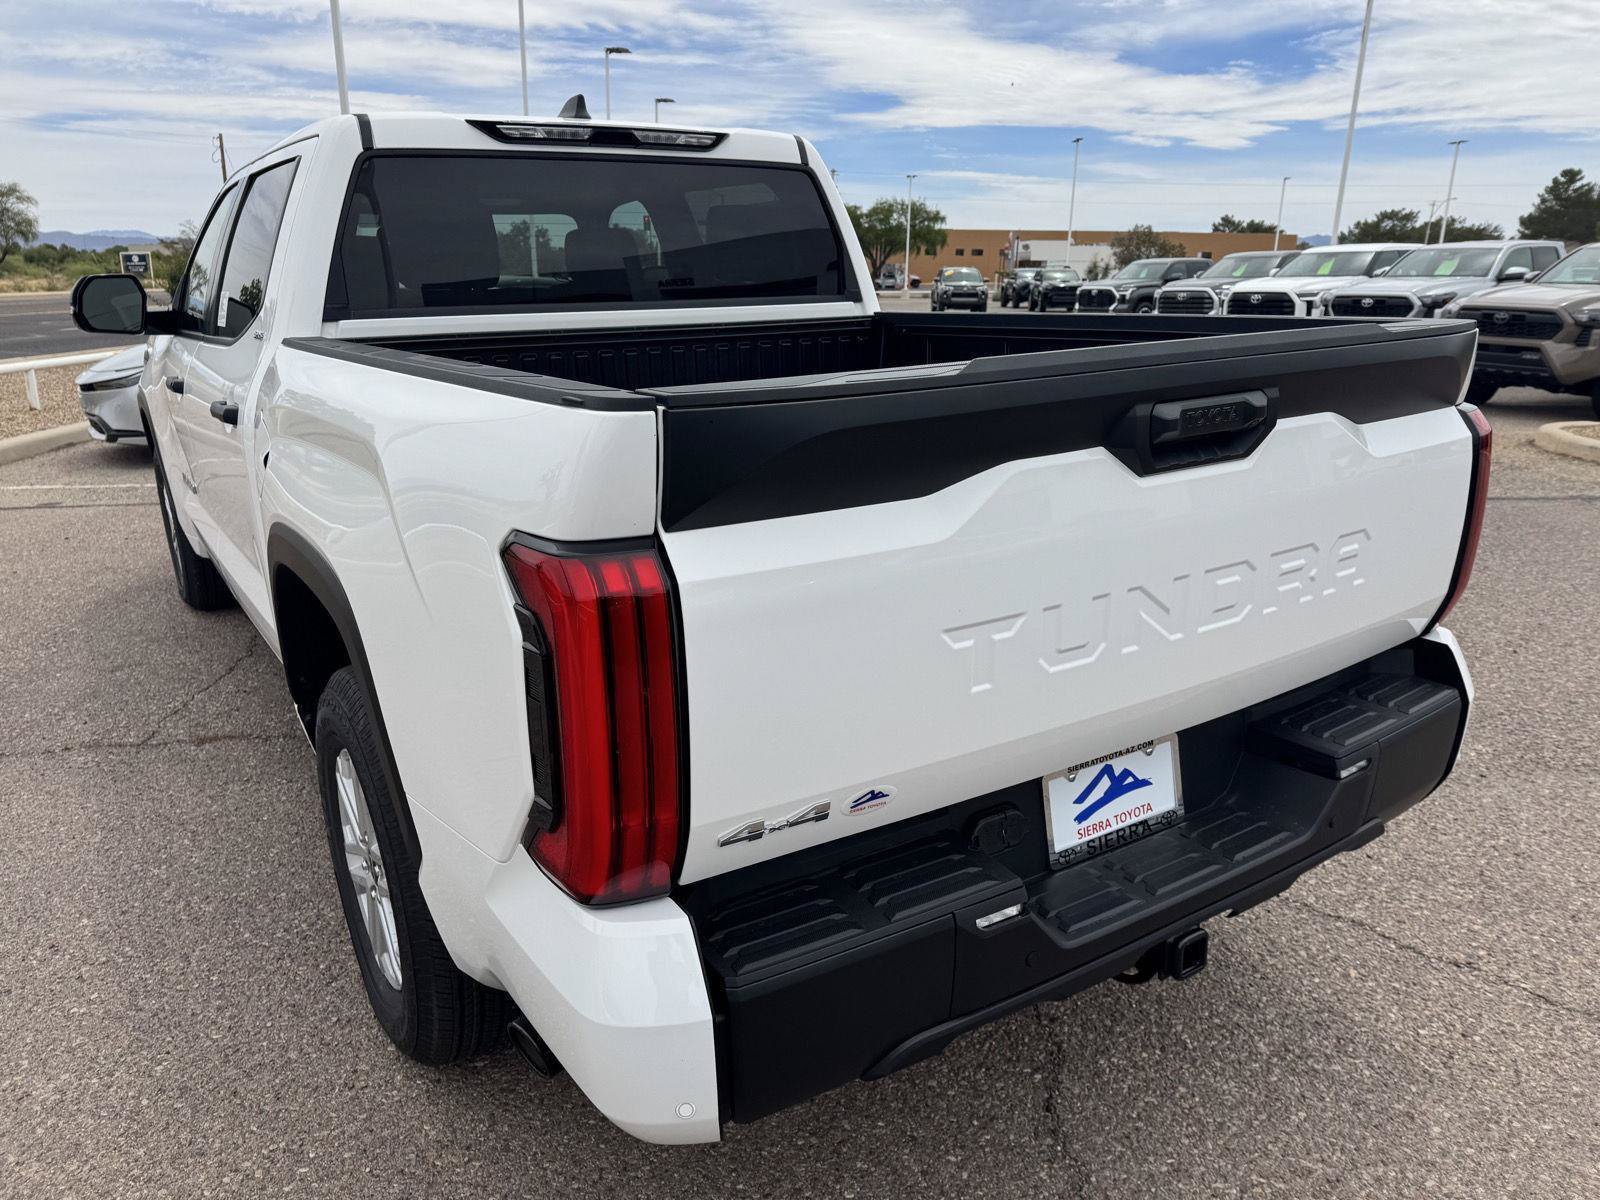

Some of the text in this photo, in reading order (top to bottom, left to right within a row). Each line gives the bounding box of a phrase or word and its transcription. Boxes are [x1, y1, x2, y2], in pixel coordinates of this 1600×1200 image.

[1185, 405, 1240, 427] TOYOTA
[940, 527, 1372, 694] TUNDRA
[1066, 739, 1155, 774] SIERRATOYOTA-AZ.COM
[867, 801, 887, 809] TOYOTA
[1076, 802, 1154, 841] SIERRA TOYOTA
[1086, 819, 1153, 856] SIERRA
